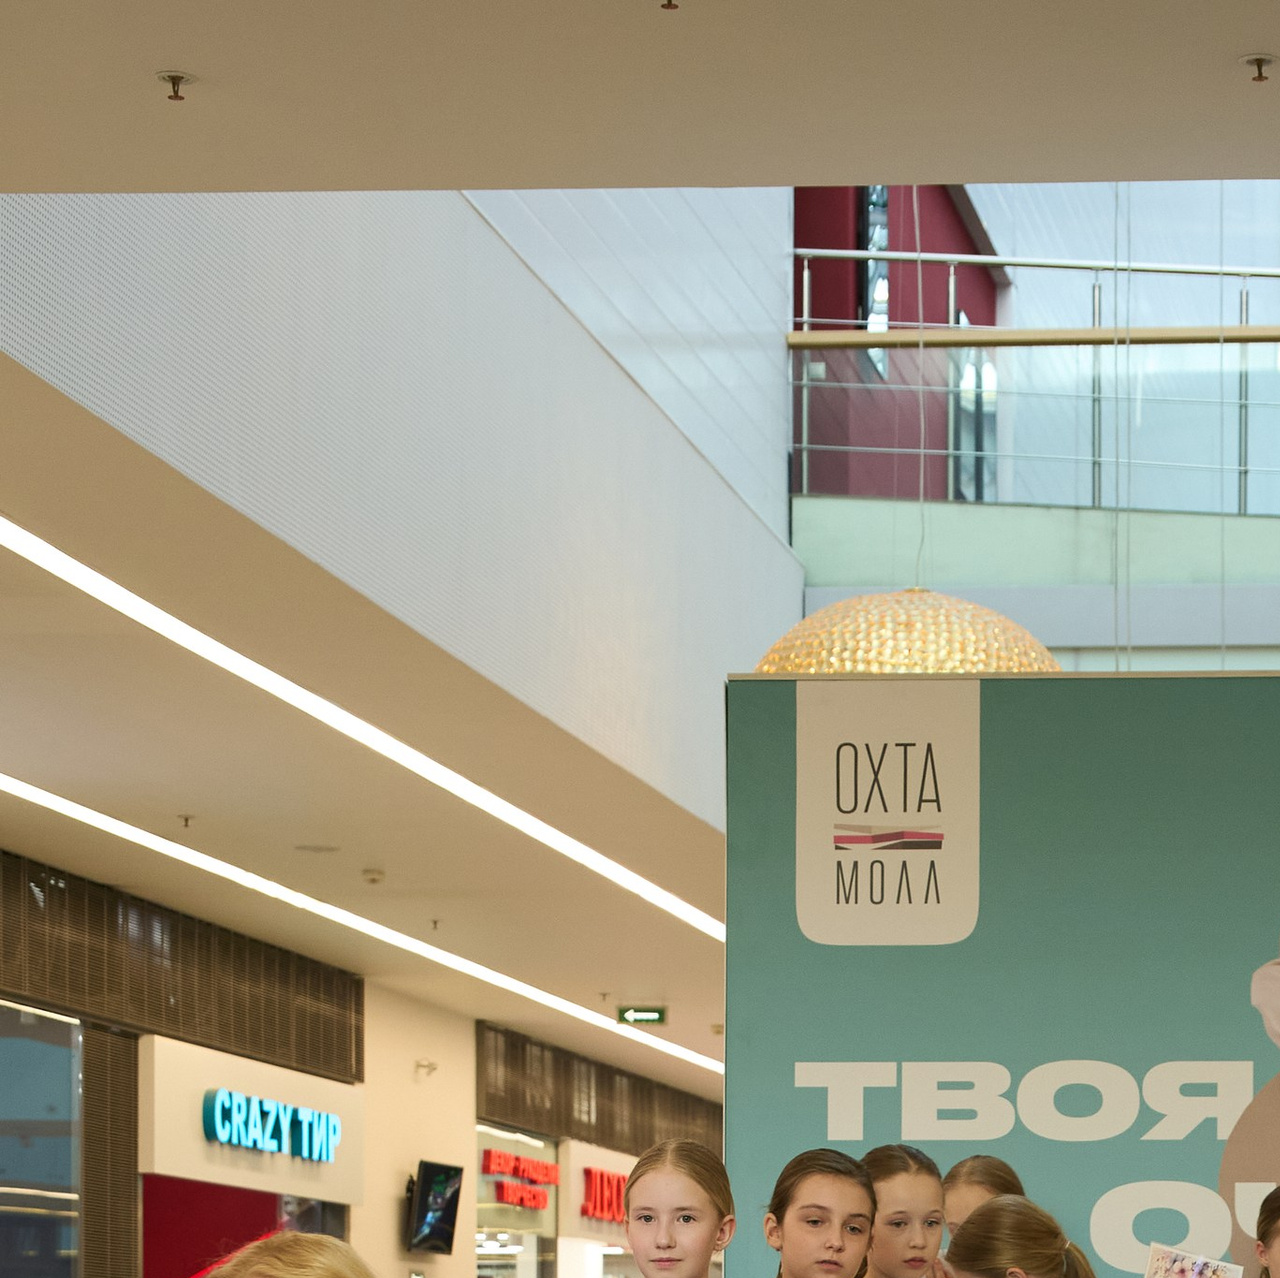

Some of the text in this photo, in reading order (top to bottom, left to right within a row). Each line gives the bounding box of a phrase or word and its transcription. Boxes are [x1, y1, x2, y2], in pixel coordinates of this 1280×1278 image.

[835, 742, 942, 814] ОХТА
[835, 859, 941, 905] МОЛЛ
[211, 1086, 342, 1164] CRAZY ТИР
[794, 1059, 1254, 1142] ТВОЯ
